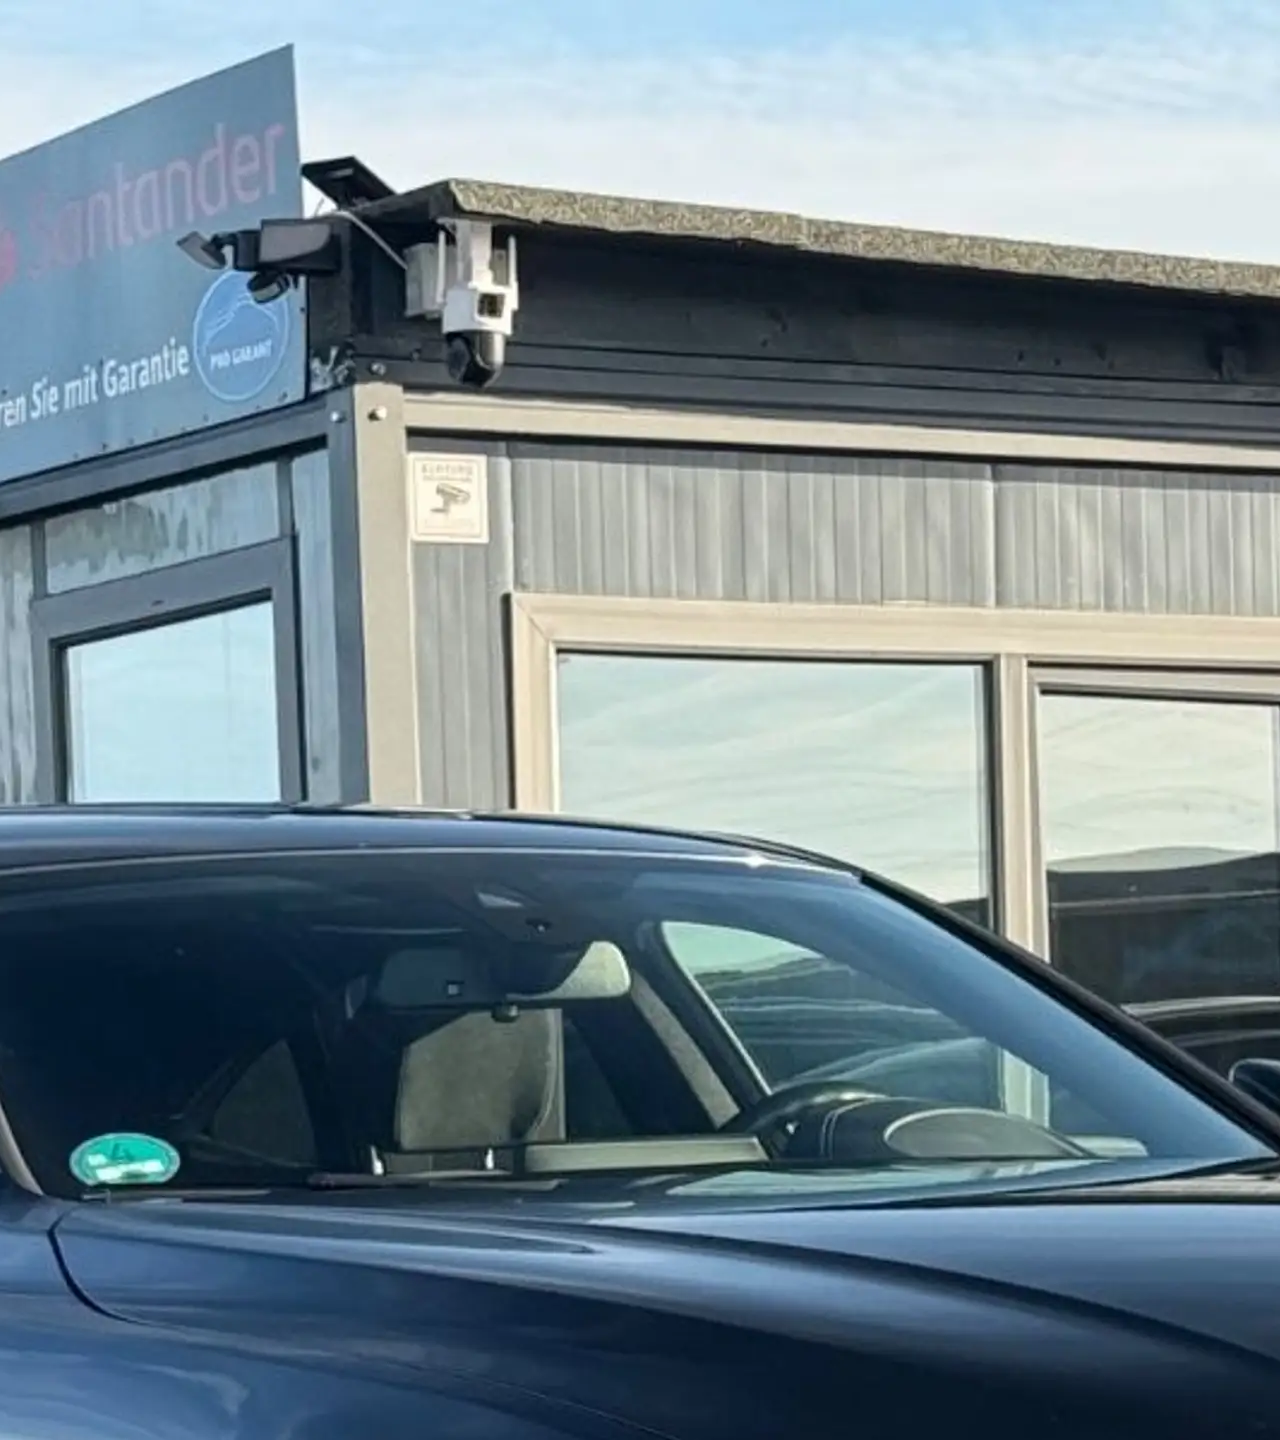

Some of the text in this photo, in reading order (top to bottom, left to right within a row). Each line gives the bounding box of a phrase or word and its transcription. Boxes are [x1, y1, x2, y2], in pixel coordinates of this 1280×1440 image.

[30, 376, 59, 421] Sie
[64, 364, 98, 410] mit
[102, 338, 191, 398] Garantie
